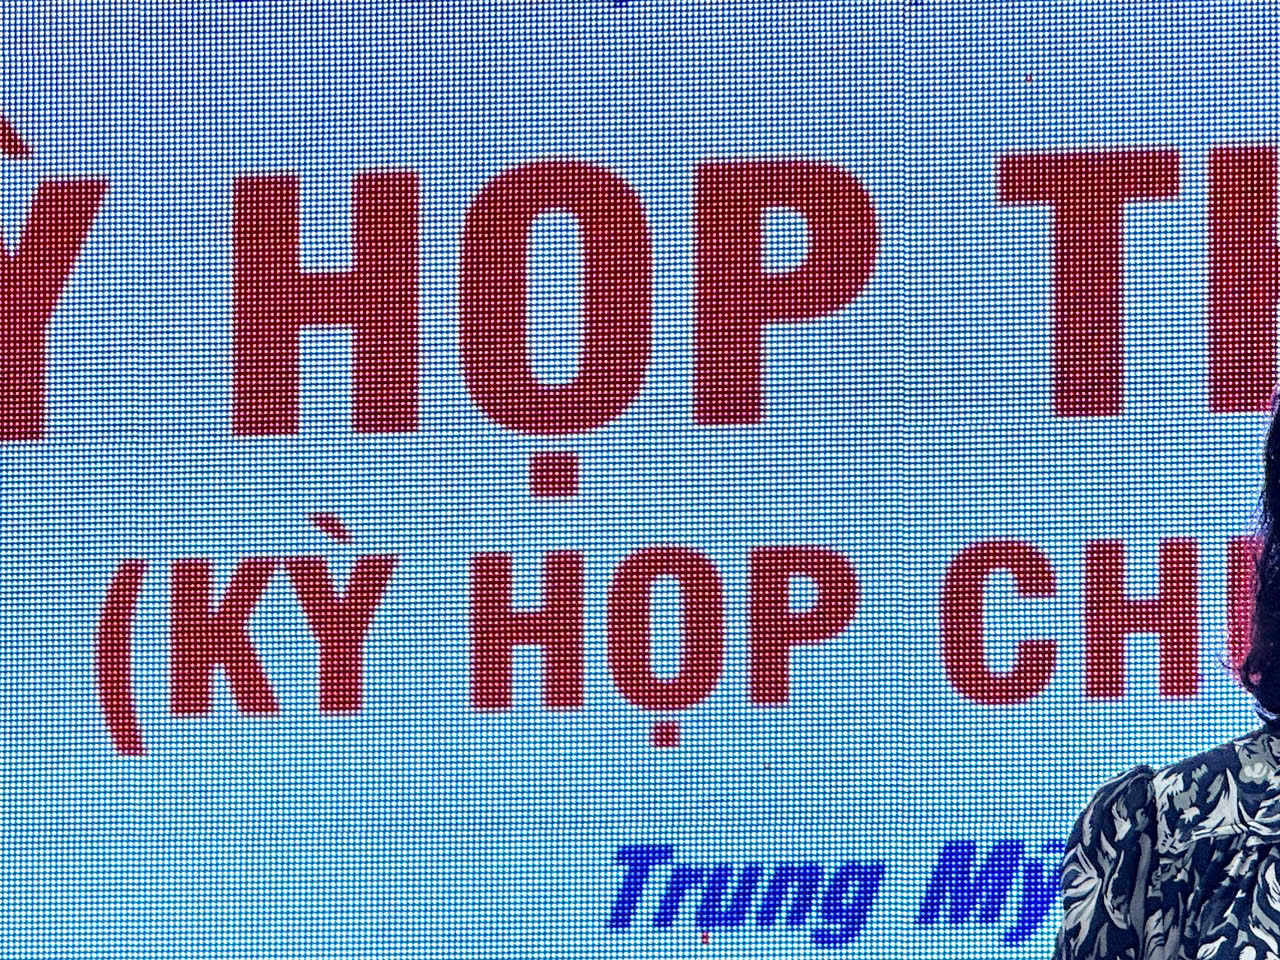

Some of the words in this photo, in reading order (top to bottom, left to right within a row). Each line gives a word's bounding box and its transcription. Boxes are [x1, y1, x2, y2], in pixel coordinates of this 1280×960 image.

[232, 156, 881, 498] HỌP
[93, 511, 399, 756] (KỲ
[469, 544, 861, 748] HỌP
[608, 844, 886, 948] Trung
